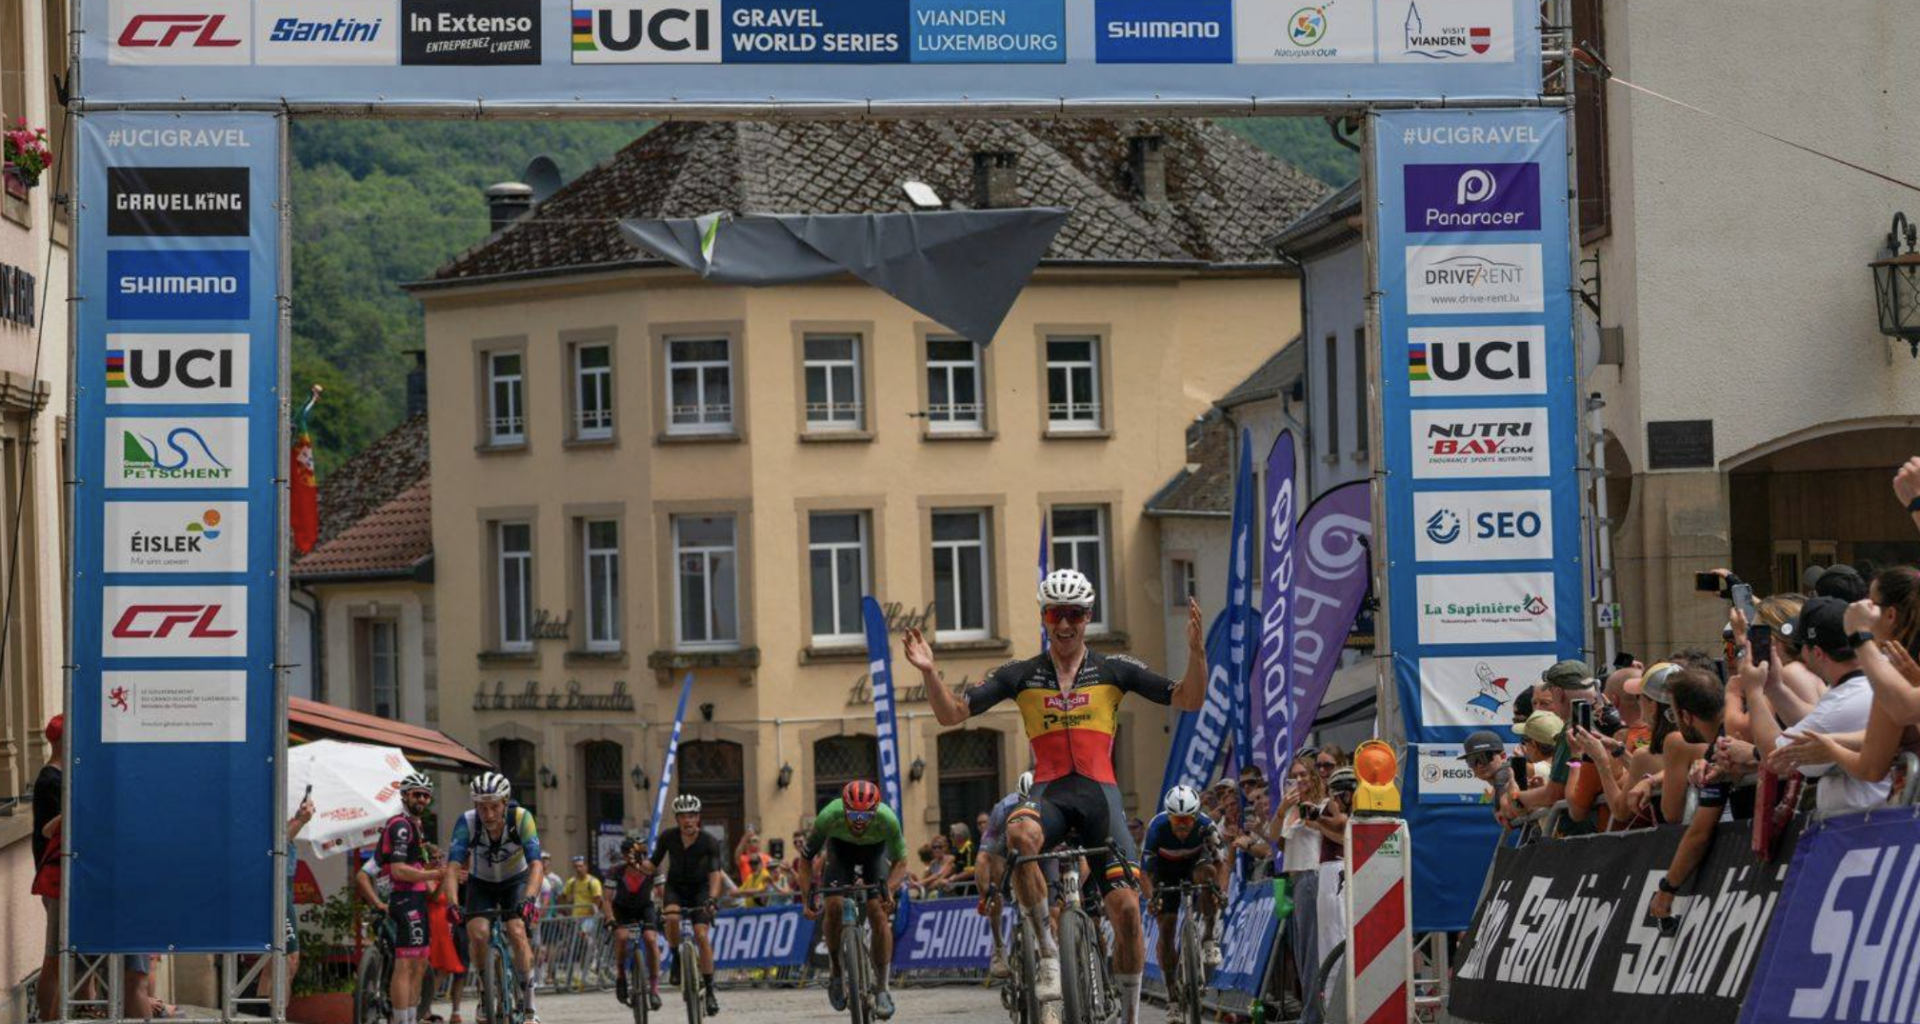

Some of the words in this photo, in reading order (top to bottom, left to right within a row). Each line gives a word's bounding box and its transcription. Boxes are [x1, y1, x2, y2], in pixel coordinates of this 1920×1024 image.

[410, 13, 431, 32] In
[438, 13, 532, 32] Extenso
[732, 8, 823, 27] GRAVEL
[917, 10, 1006, 26] VIANDEN
[117, 14, 242, 47] CFL
[269, 18, 382, 42] Santini
[598, 8, 709, 51] UCI
[1107, 21, 1220, 38] SHIMANO
[426, 37, 490, 53] ENTREPRENEZ
[732, 33, 816, 52] WORLD
[823, 33, 899, 52] SERIES
[918, 34, 1057, 51] LUXEMBOURG
[1410, 36, 1466, 46] VIANDEN
[107, 129, 250, 147] #UCIGRAVEL
[1403, 126, 1540, 144] #UCIGRAVEL
[116, 192, 242, 210] GRAVELKING
[1426, 208, 1524, 226] Panaracer
[120, 276, 237, 293] SHIMANO
[1431, 293, 1519, 304] www.drive-rent.lu
[129, 349, 232, 389] UCI
[1431, 341, 1531, 381] UCI
[1428, 422, 1533, 438] NUTRI
[123, 468, 232, 479] PETSCHENT
[1477, 511, 1541, 538] SEO
[131, 531, 201, 553] ÉISLEK
[1425, 604, 1442, 615] La
[1447, 602, 1521, 617] Sapinière
[112, 604, 238, 638] CFL
[1442, 769, 1475, 779] REGIS
